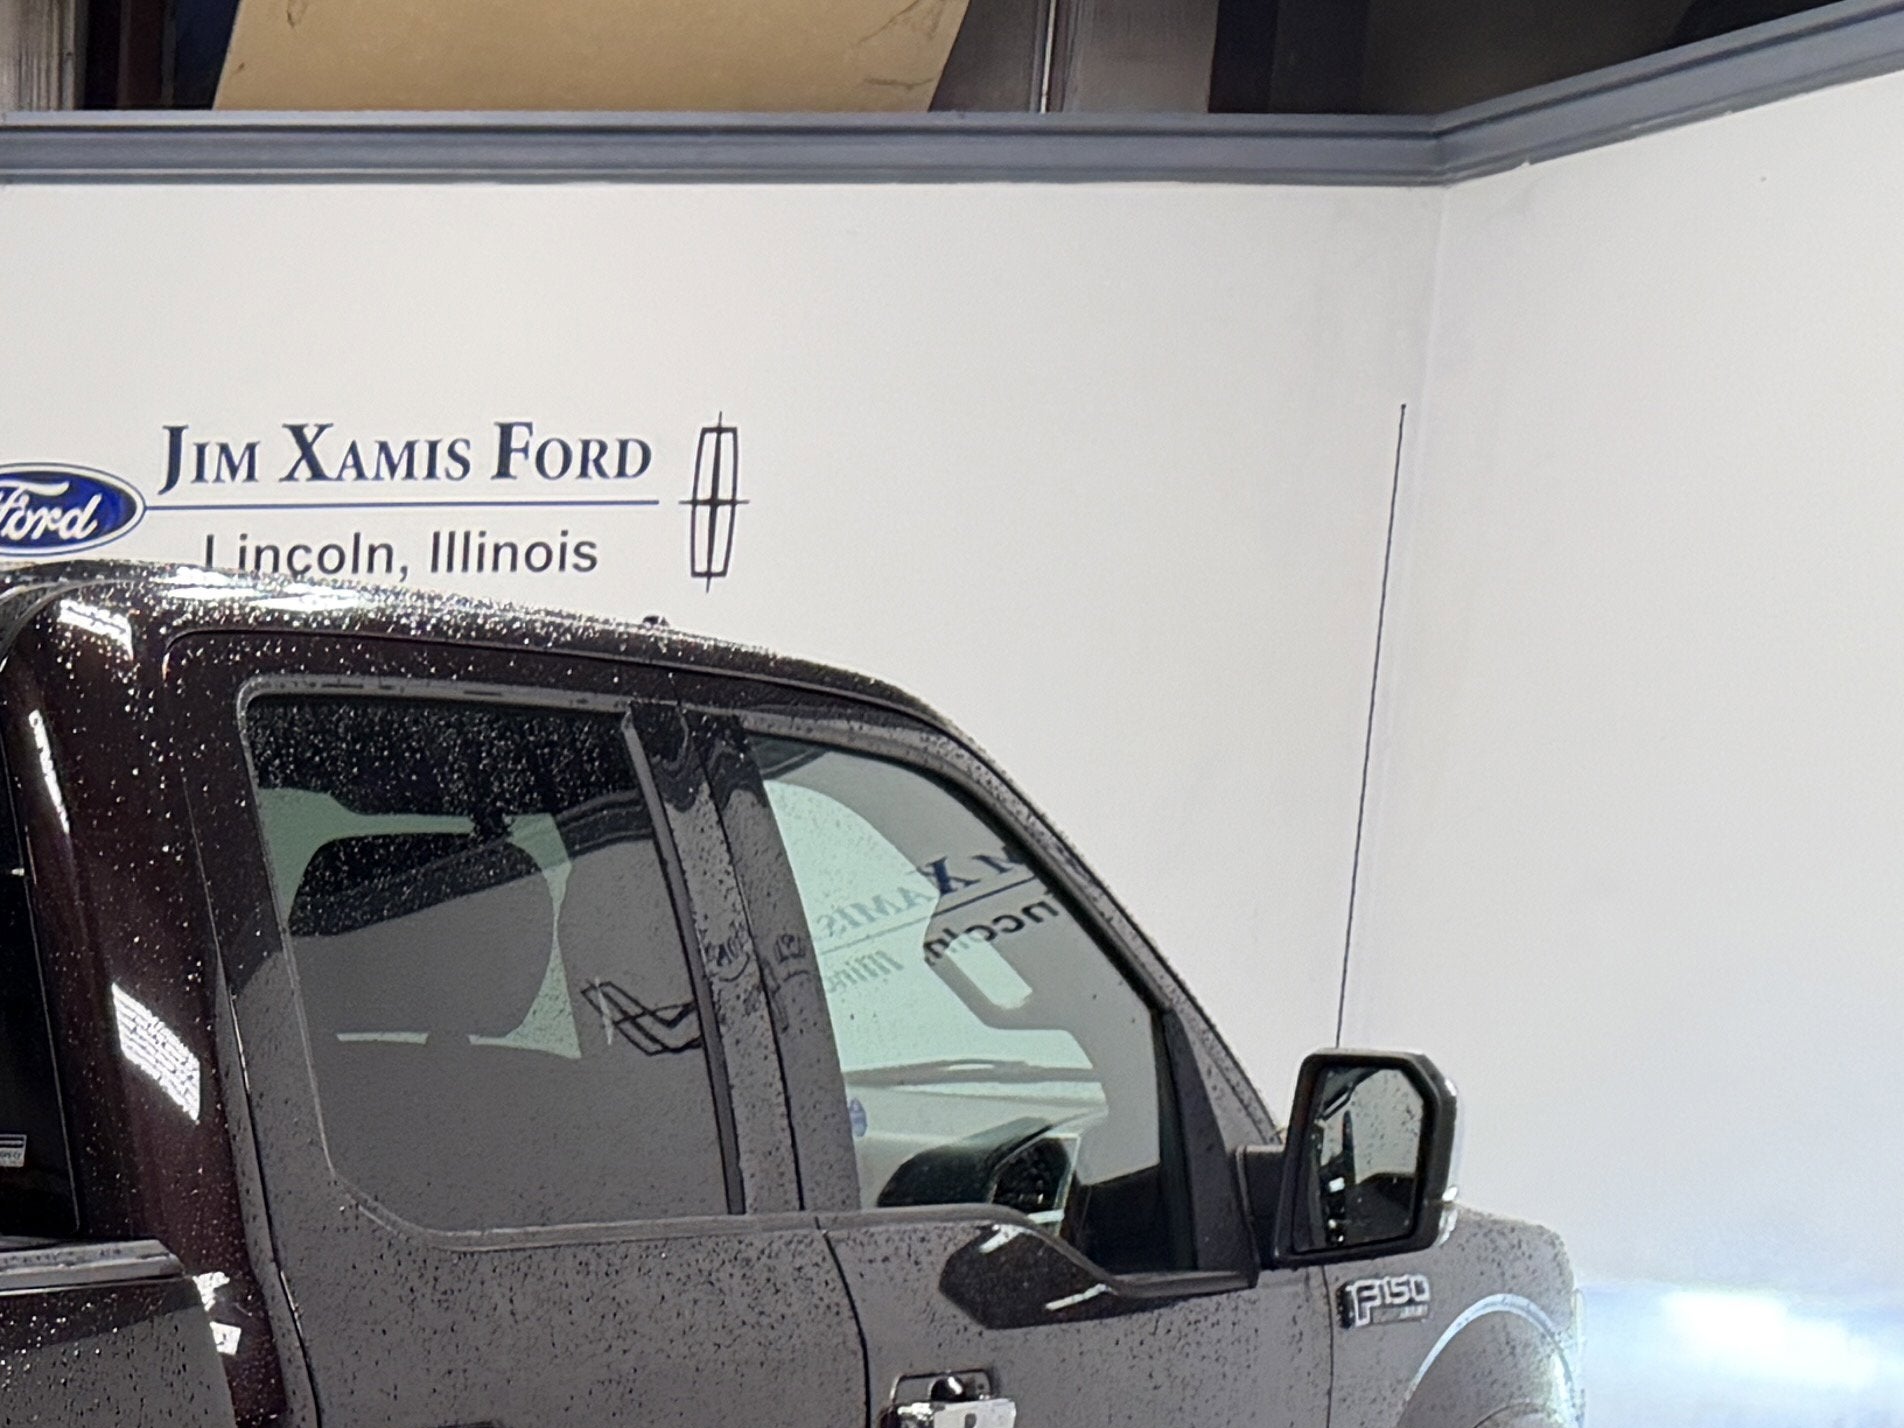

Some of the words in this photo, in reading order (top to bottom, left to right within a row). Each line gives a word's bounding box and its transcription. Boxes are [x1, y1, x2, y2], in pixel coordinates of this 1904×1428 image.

[158, 424, 259, 496] JIM
[278, 422, 472, 483] XAMIS
[491, 420, 653, 481] FORD
[430, 528, 599, 574] Illinois
